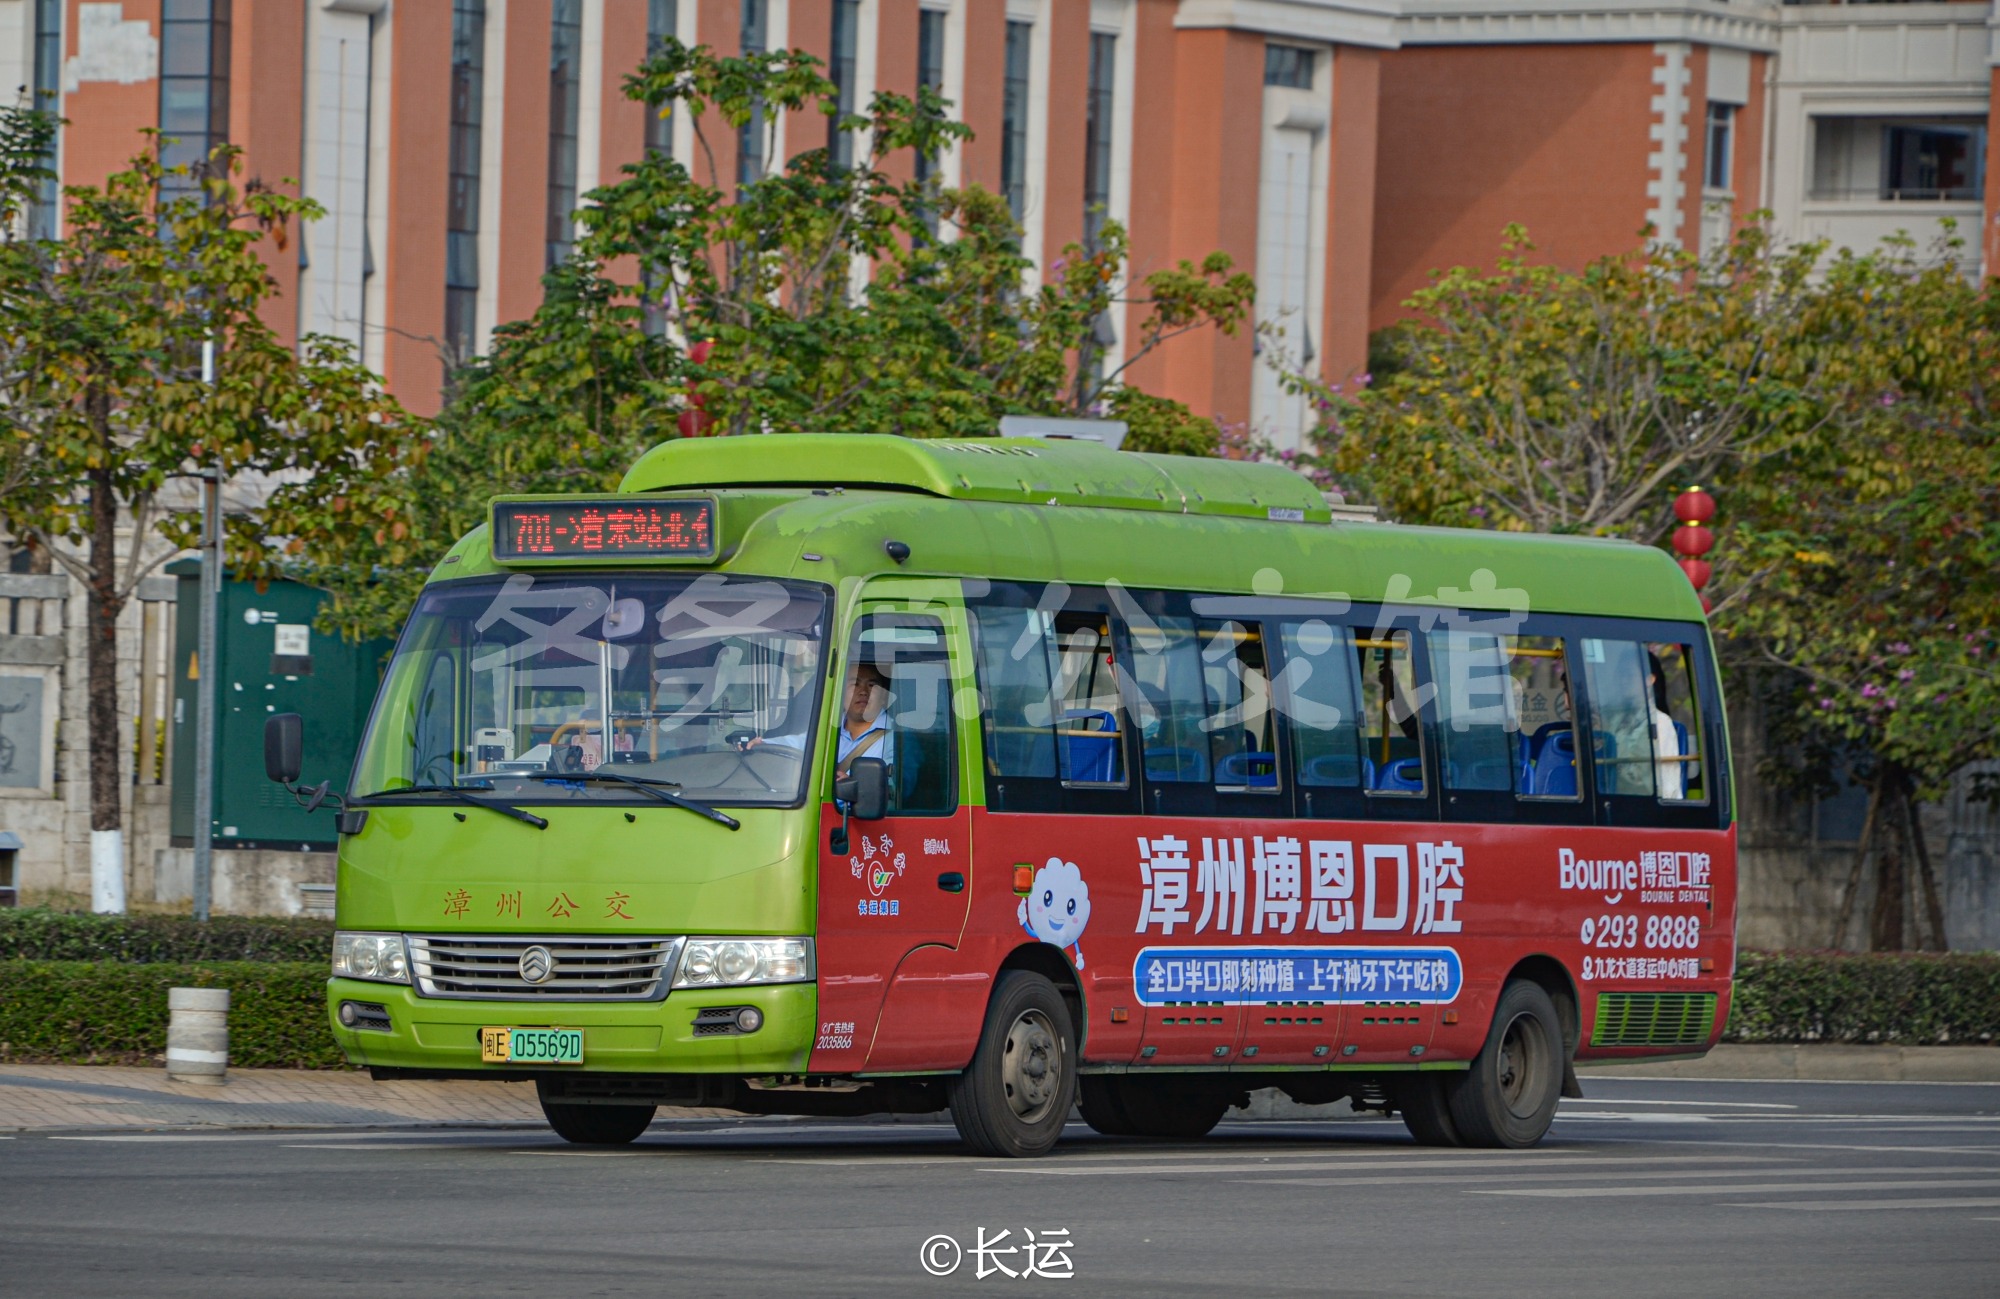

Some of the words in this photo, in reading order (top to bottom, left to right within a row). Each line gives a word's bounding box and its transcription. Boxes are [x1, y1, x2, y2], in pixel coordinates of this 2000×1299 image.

[1558, 847, 1638, 890] Bourne
[1640, 851, 1711, 889] 博恩口腔
[1135, 834, 1464, 936] 漳州博恩口腔
[1641, 890, 1674, 903] BOURNE
[1678, 890, 1709, 903] DENTAL
[443, 888, 635, 921] 漳州公交
[858, 899, 899, 915] 长运集团
[1596, 915, 1638, 949] 293
[1645, 915, 1700, 949] 8888
[1594, 957, 1700, 979] 九龙大道客运中心对面
[826, 1021, 855, 1034] 广告热线
[816, 1035, 853, 1049] 2035866
